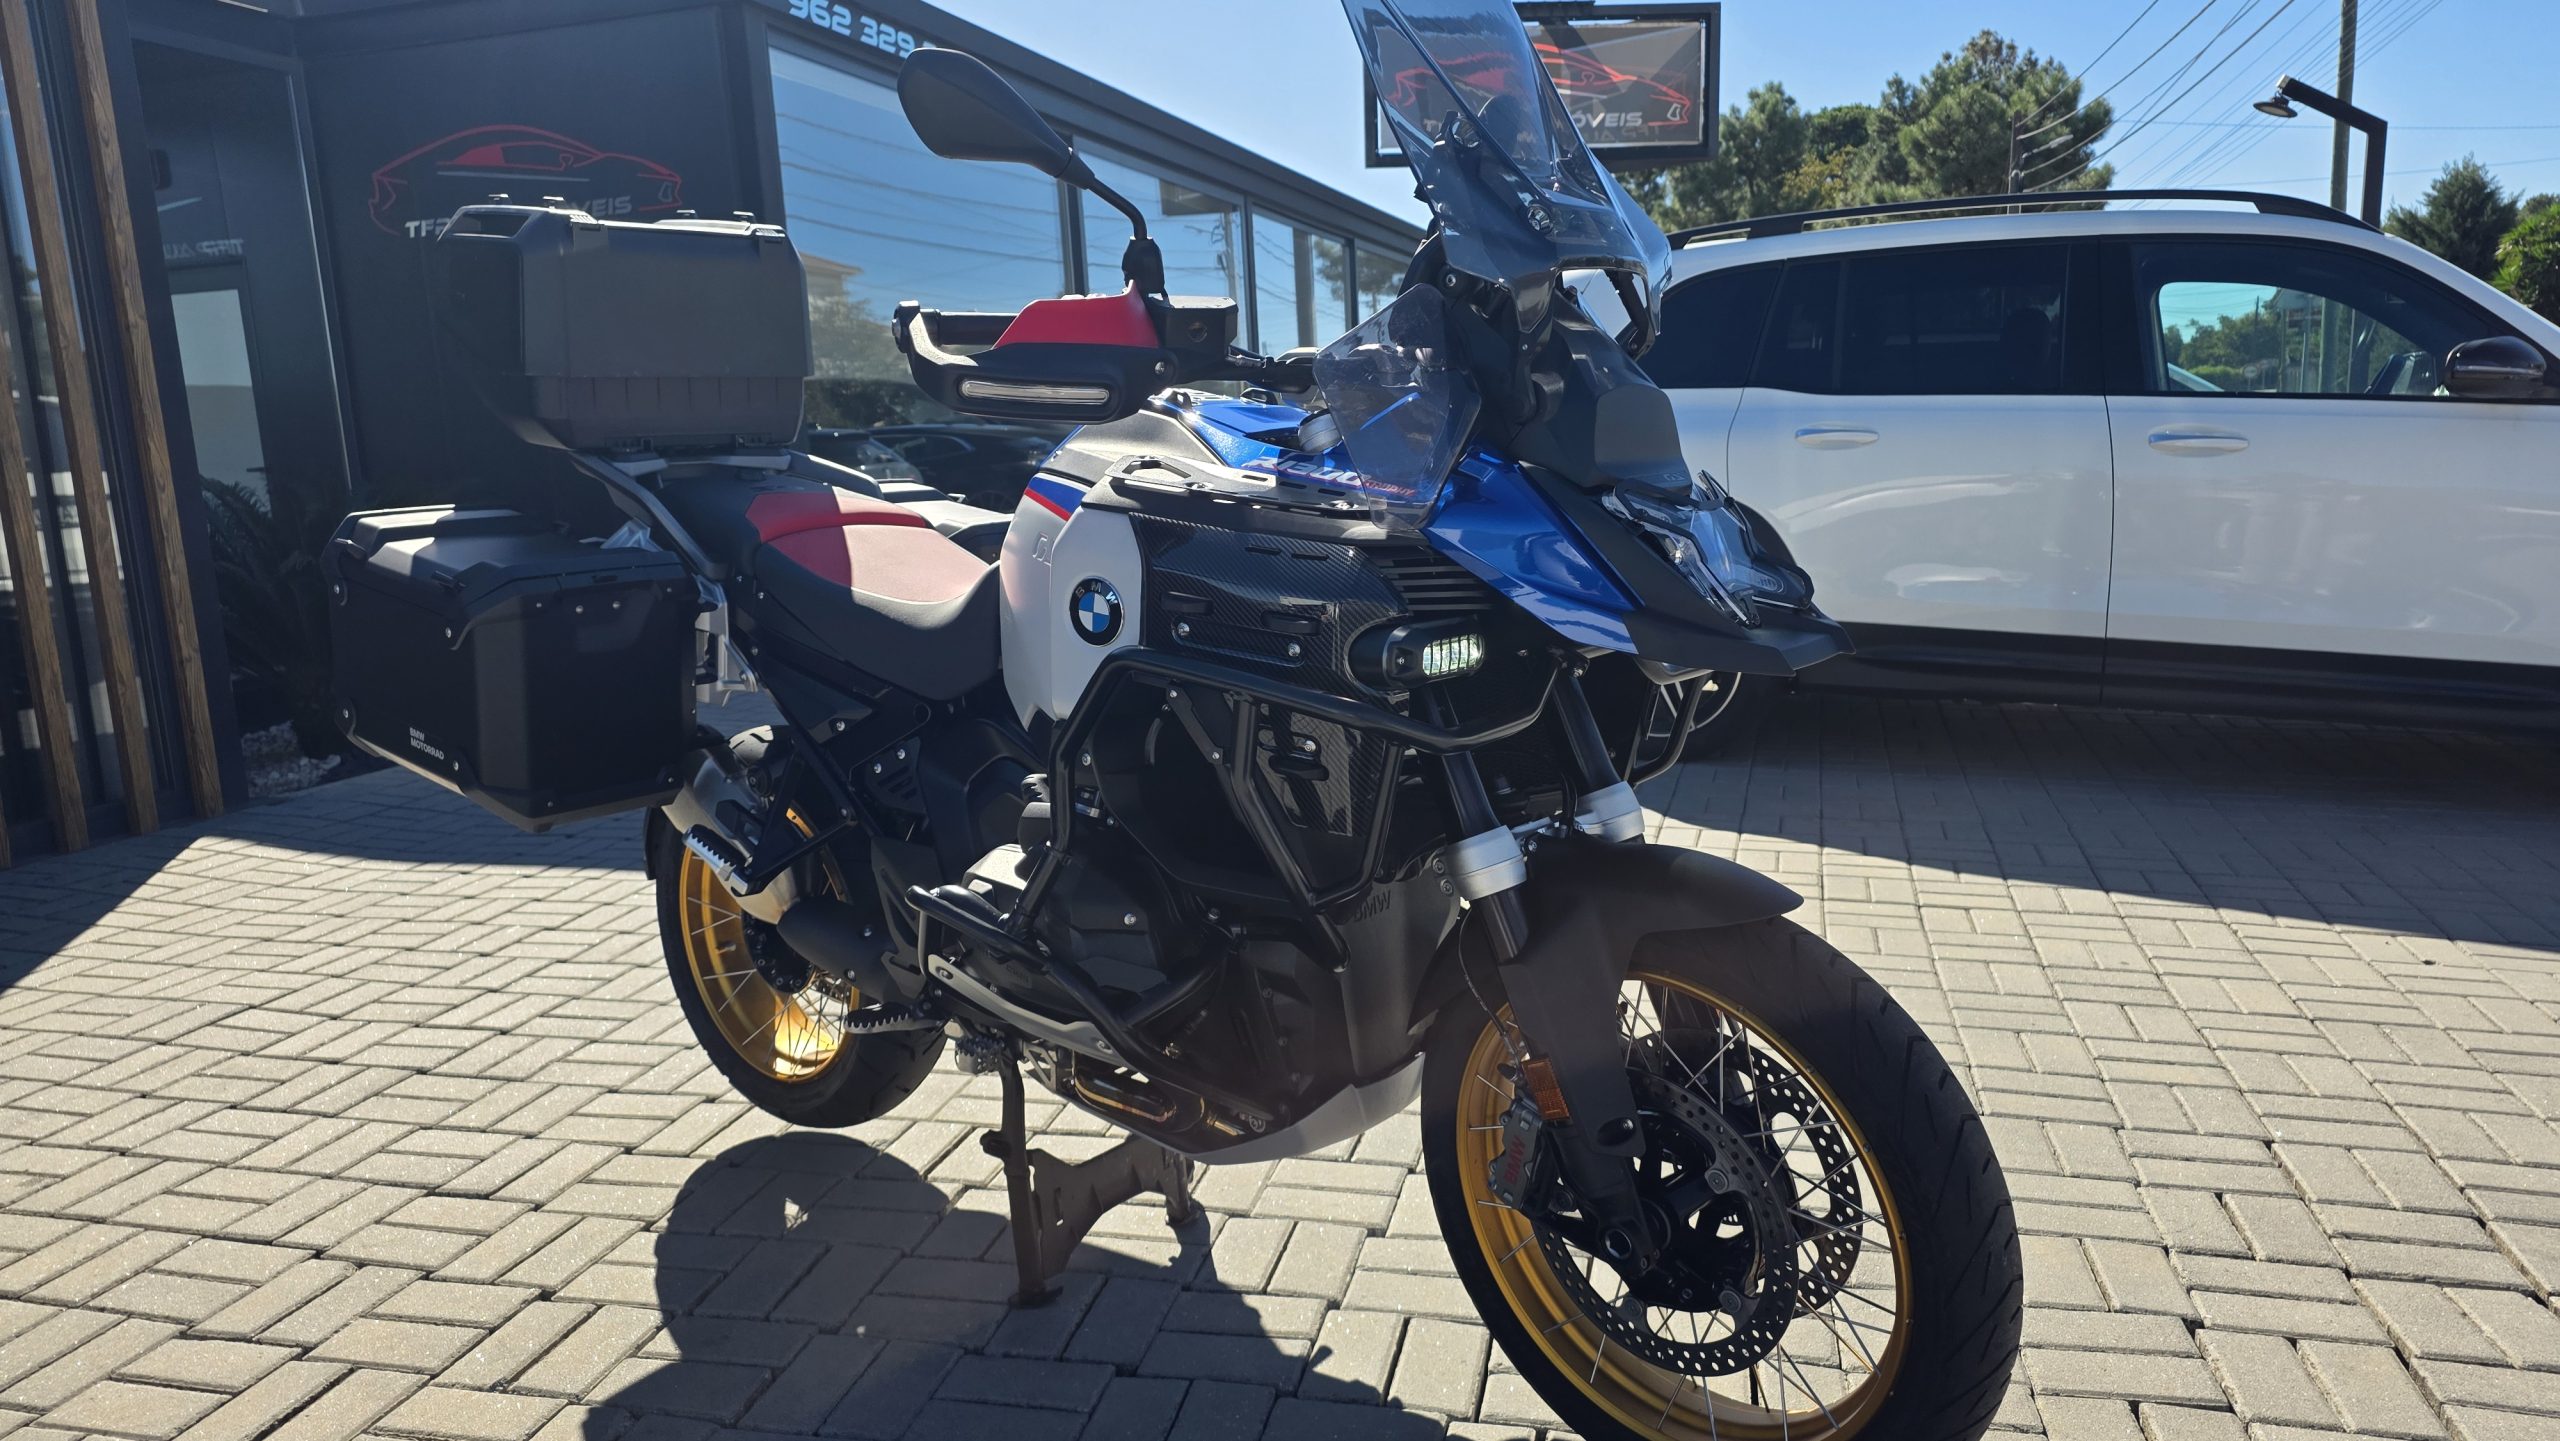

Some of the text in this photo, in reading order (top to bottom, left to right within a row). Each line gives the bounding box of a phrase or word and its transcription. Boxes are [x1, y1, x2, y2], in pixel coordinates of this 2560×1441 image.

[789, 0, 915, 58] 962 329
[1075, 581, 1118, 605] BMW
[409, 727, 425, 741] BMW
[410, 737, 445, 760] MOTORRAD
[1503, 1135, 1526, 1185] BMW
